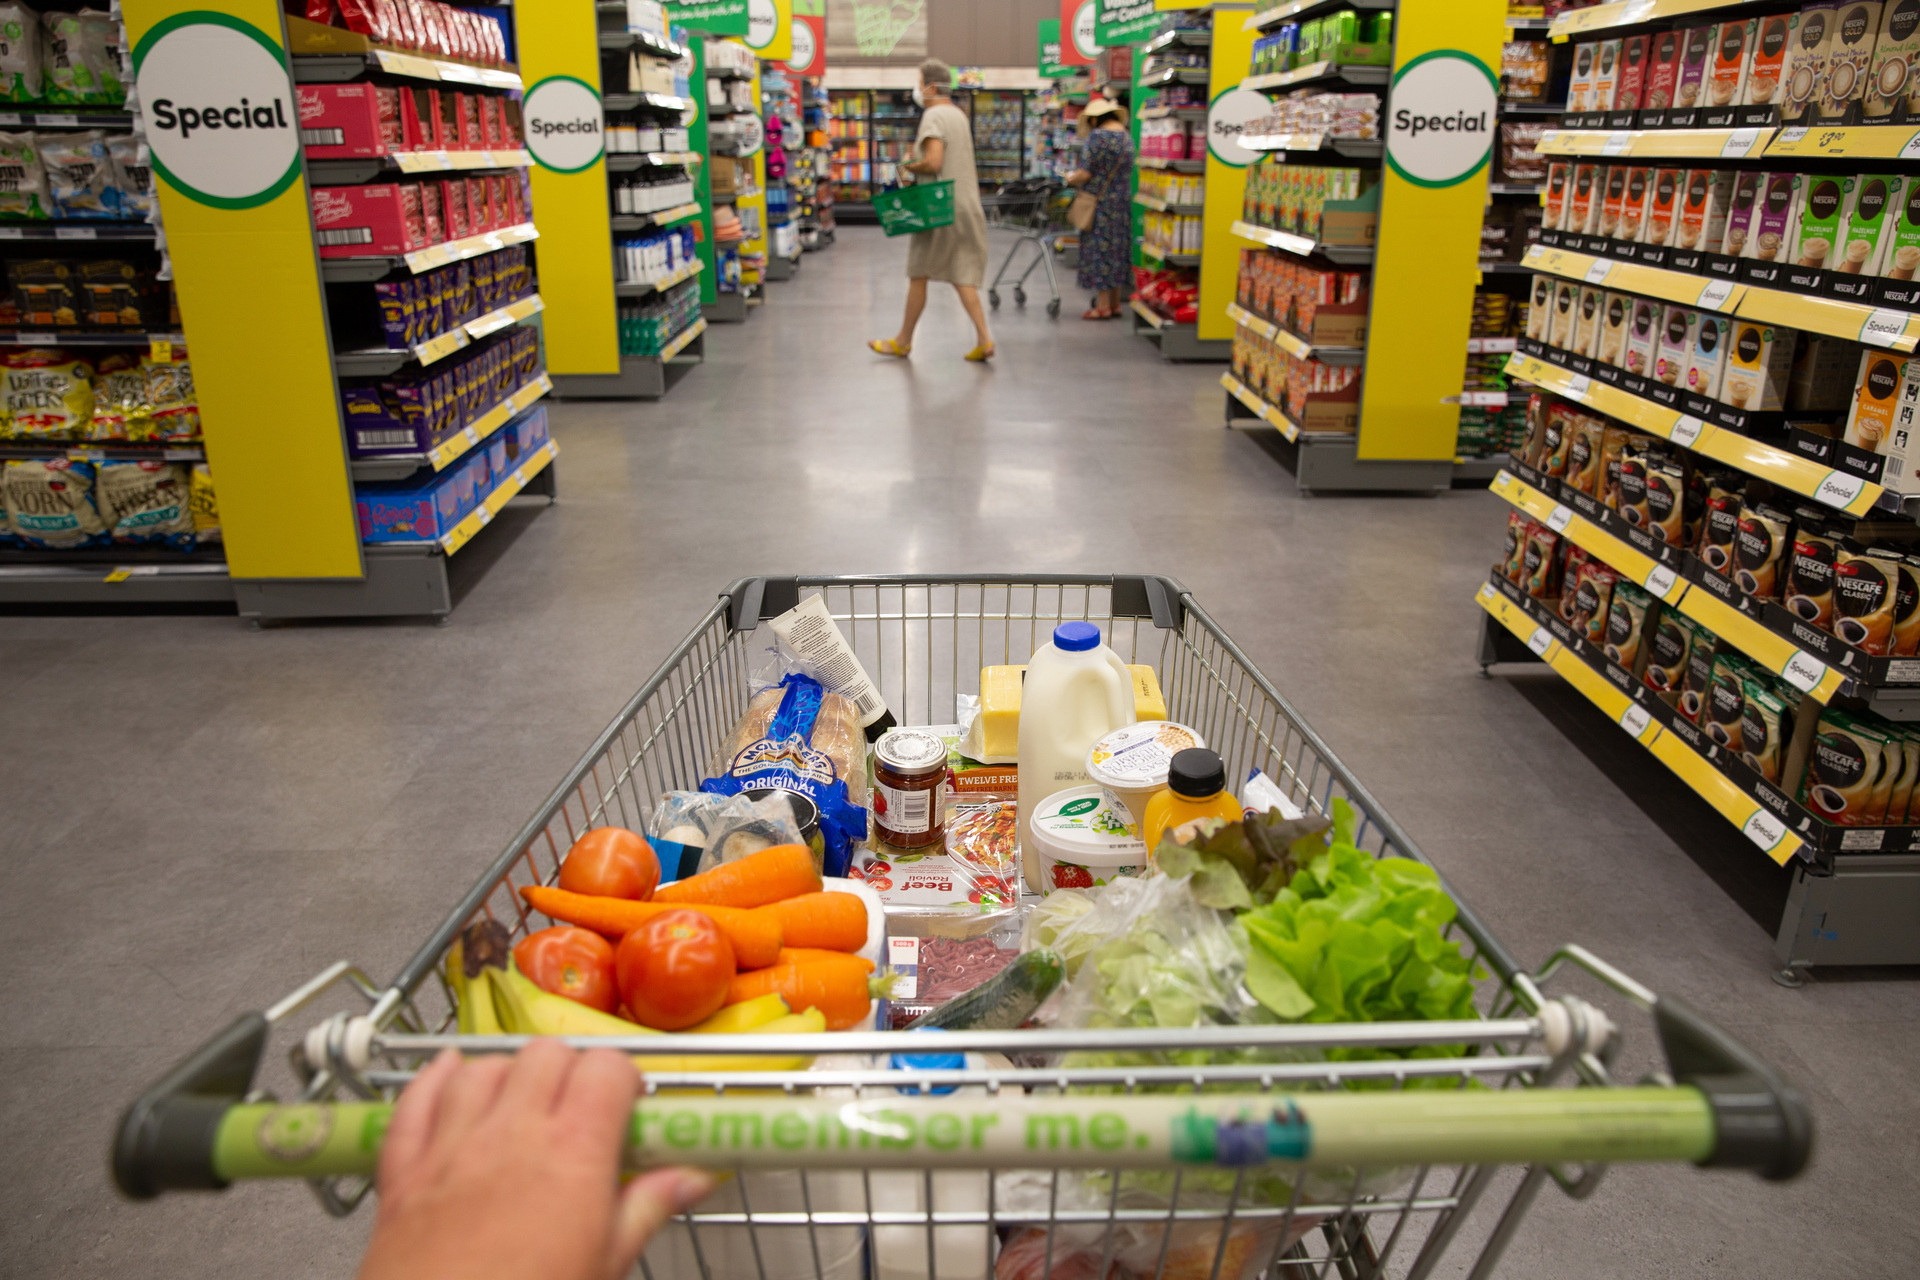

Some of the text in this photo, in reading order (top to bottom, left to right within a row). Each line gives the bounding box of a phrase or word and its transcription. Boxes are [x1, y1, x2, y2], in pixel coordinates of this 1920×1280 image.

[1880, 45, 1903, 53] Almond
[152, 98, 288, 138] Special
[1394, 110, 1486, 137] Special
[531, 117, 598, 138] Special
[1852, 227, 1877, 235] HAZELNUT
[1867, 321, 1900, 334] Special
[1862, 403, 1889, 416] CARAMEL
[1823, 482, 1854, 499] Special
[1798, 568, 1824, 582] CLASSIC
[1842, 589, 1874, 601] CLASSIC
[1789, 661, 1818, 682] Special
[1821, 759, 1850, 775] CLASSIC
[744, 776, 817, 797] ORIGINAL
[958, 776, 997, 785] TWELVE
[1751, 818, 1777, 842] Special
[900, 882, 953, 891] Beef
[636, 1103, 1152, 1152] remember me.
